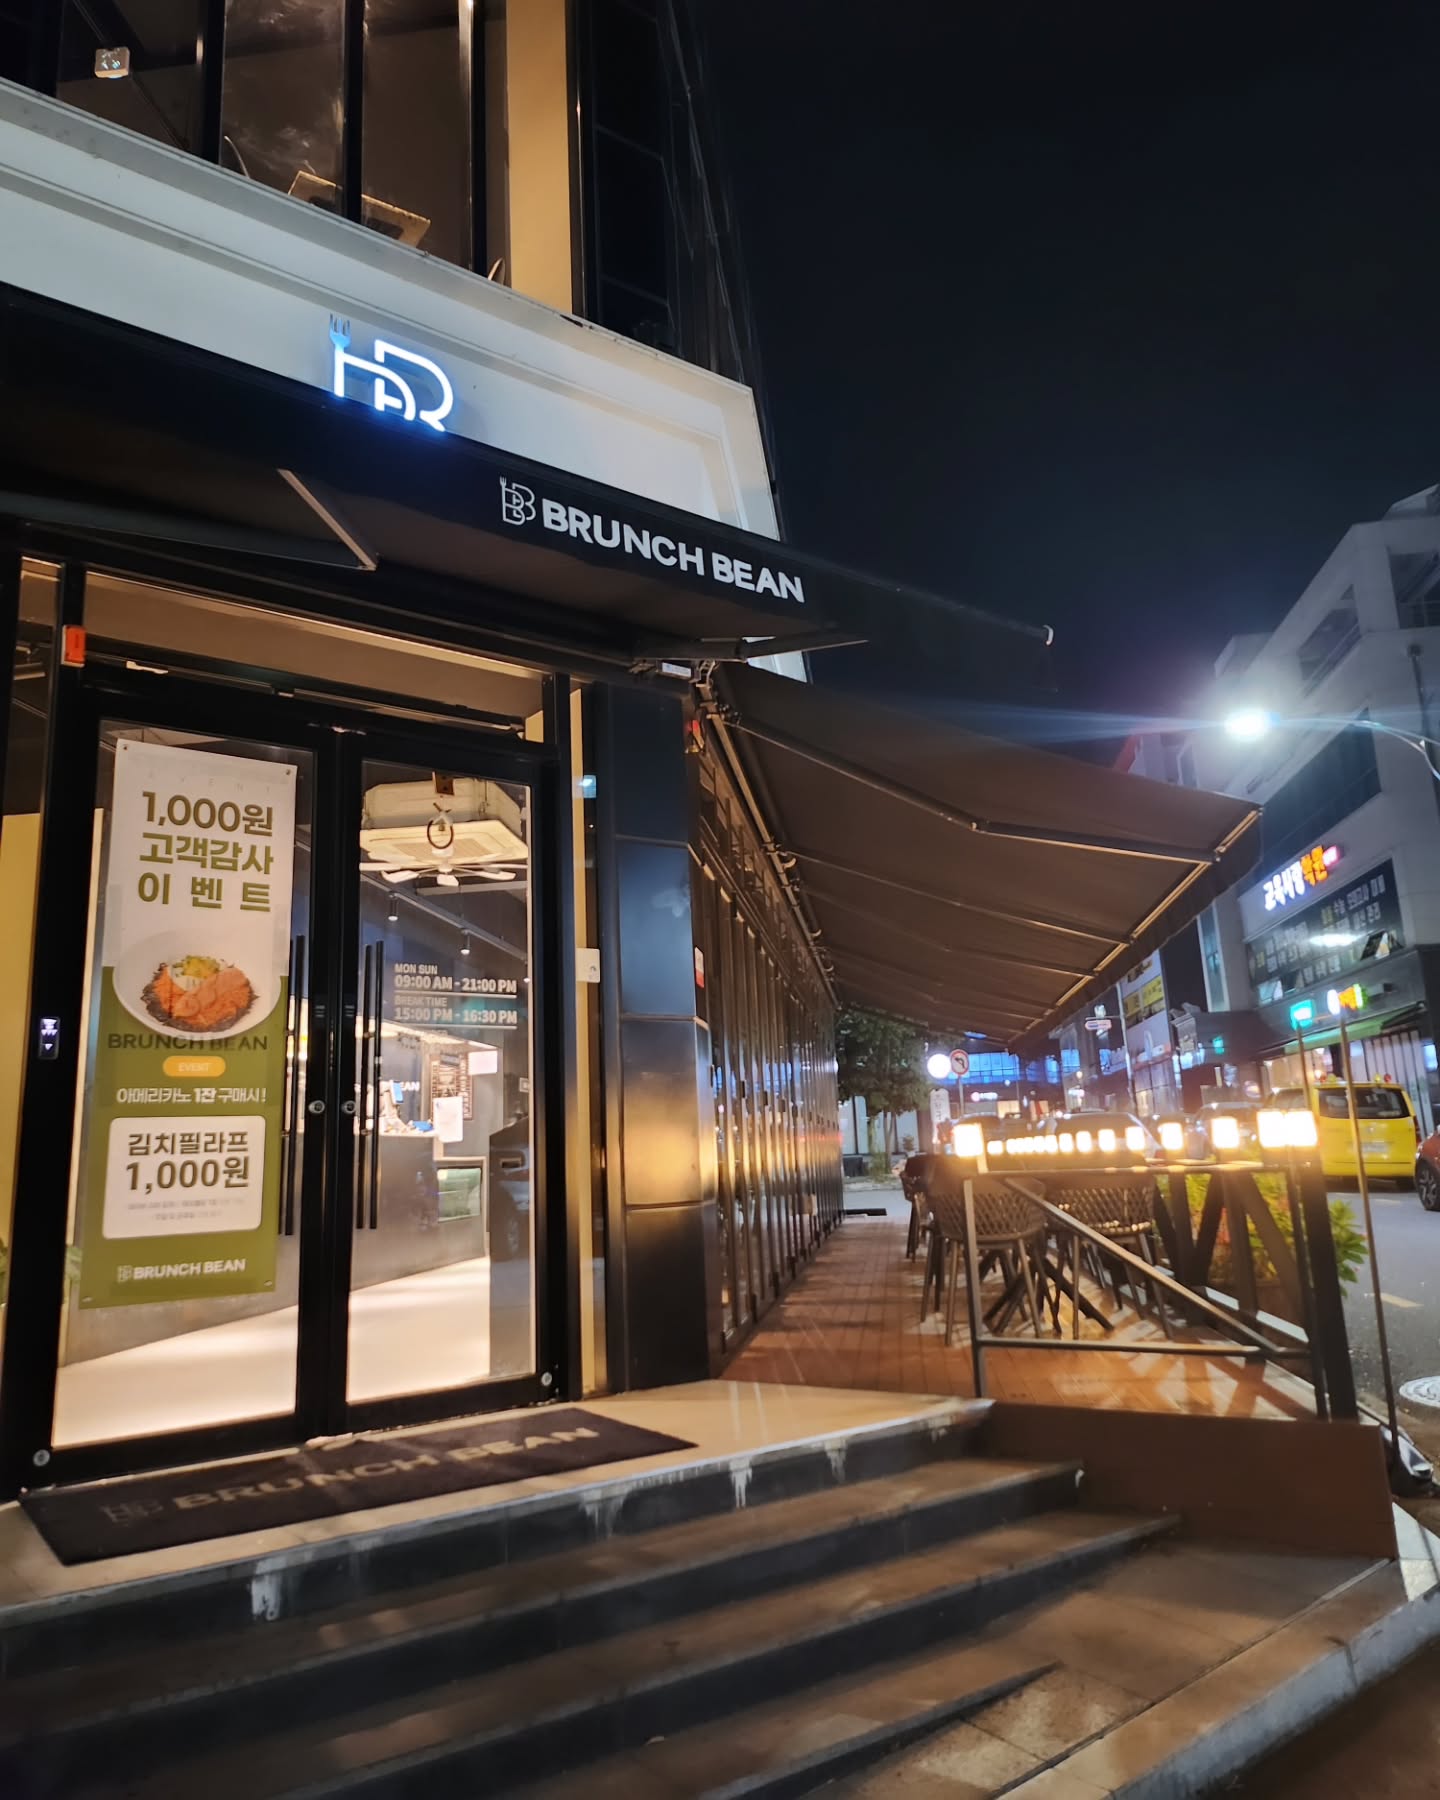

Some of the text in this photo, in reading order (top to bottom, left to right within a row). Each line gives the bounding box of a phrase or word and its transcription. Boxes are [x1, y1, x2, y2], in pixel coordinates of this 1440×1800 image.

[541, 498, 705, 576] BRUNCH
[711, 552, 805, 603] BEAN
[142, 791, 273, 837] 1,000원
[139, 832, 274, 875] 고객감사
[394, 963, 438, 975] MON SUN
[394, 975, 431, 989] 09:00
[432, 976, 453, 990] AM
[462, 978, 497, 992] 21:00
[498, 979, 517, 993] PM
[426, 997, 448, 1007] TIME
[394, 1007, 431, 1021] 15:00
[432, 1008, 453, 1022] PM
[463, 1010, 497, 1023] 16:30
[498, 1010, 518, 1024] PM
[116, 1088, 191, 1104] 아메리카노
[194, 1087, 216, 1102] 1잔
[128, 1131, 249, 1156] 김치필라프
[126, 1156, 250, 1195] 1,000원
[133, 1261, 201, 1280] BRUNCH
[203, 1258, 247, 1273] BEAN
[173, 1427, 600, 1509] BRUNCH BEAN
